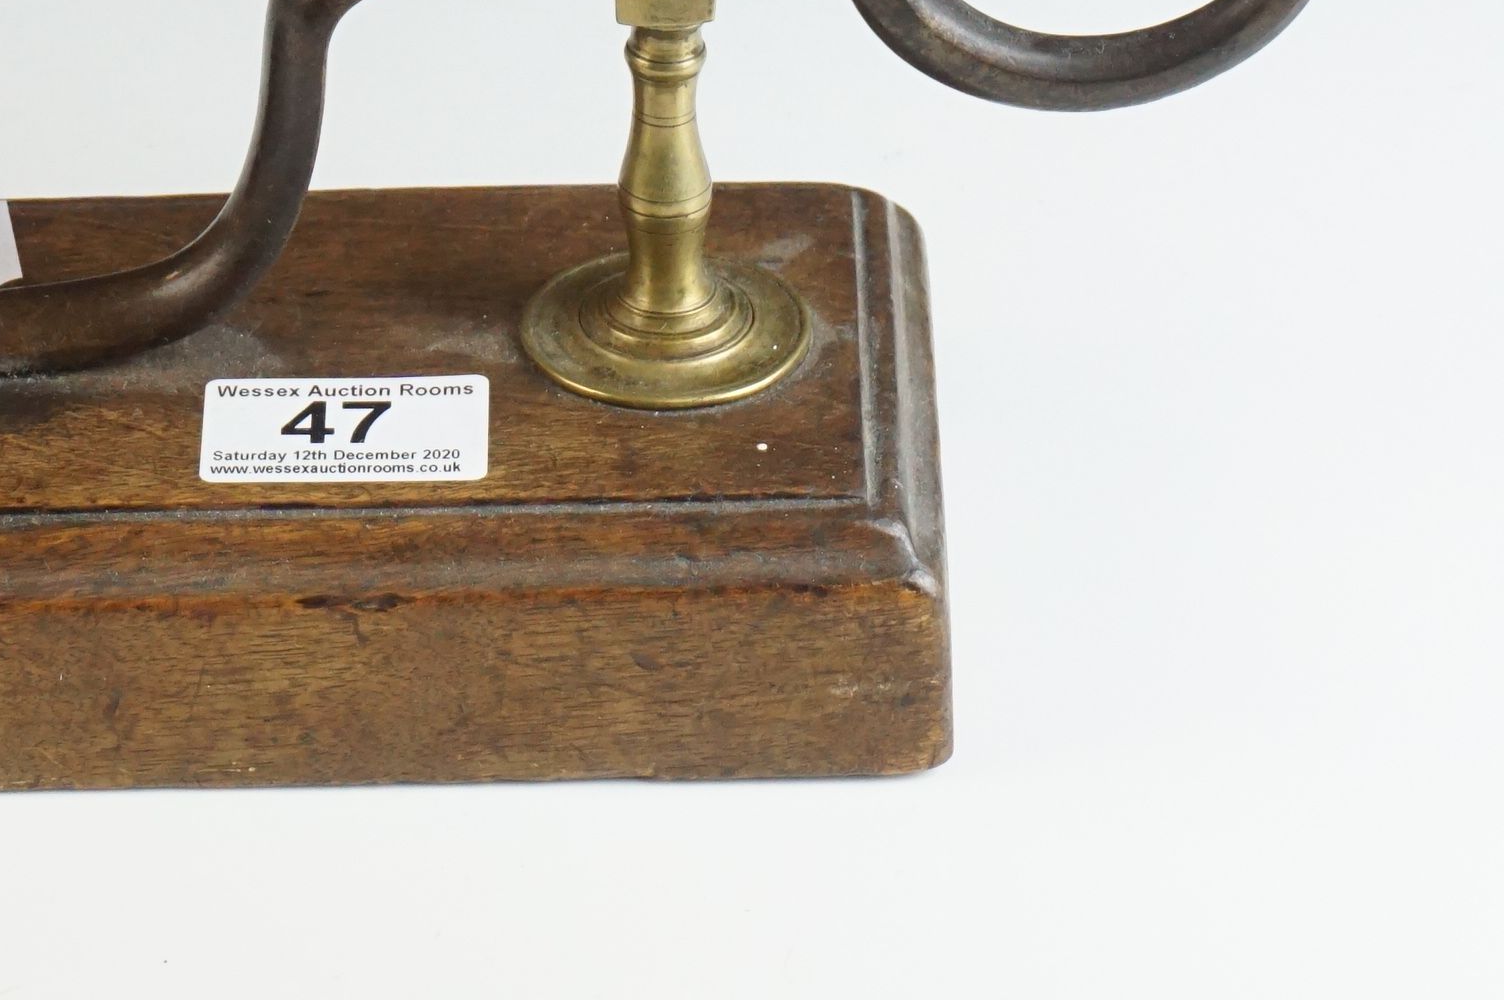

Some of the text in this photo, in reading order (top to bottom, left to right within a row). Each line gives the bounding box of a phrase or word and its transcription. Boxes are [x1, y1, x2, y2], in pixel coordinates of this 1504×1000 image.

[217, 383, 474, 398] Wessex Auction Rooms
[280, 400, 392, 444] 47
[212, 449, 461, 463] Saturday 12th December 2020
[210, 461, 462, 474] www.wessexauctionrooms.co.uk
